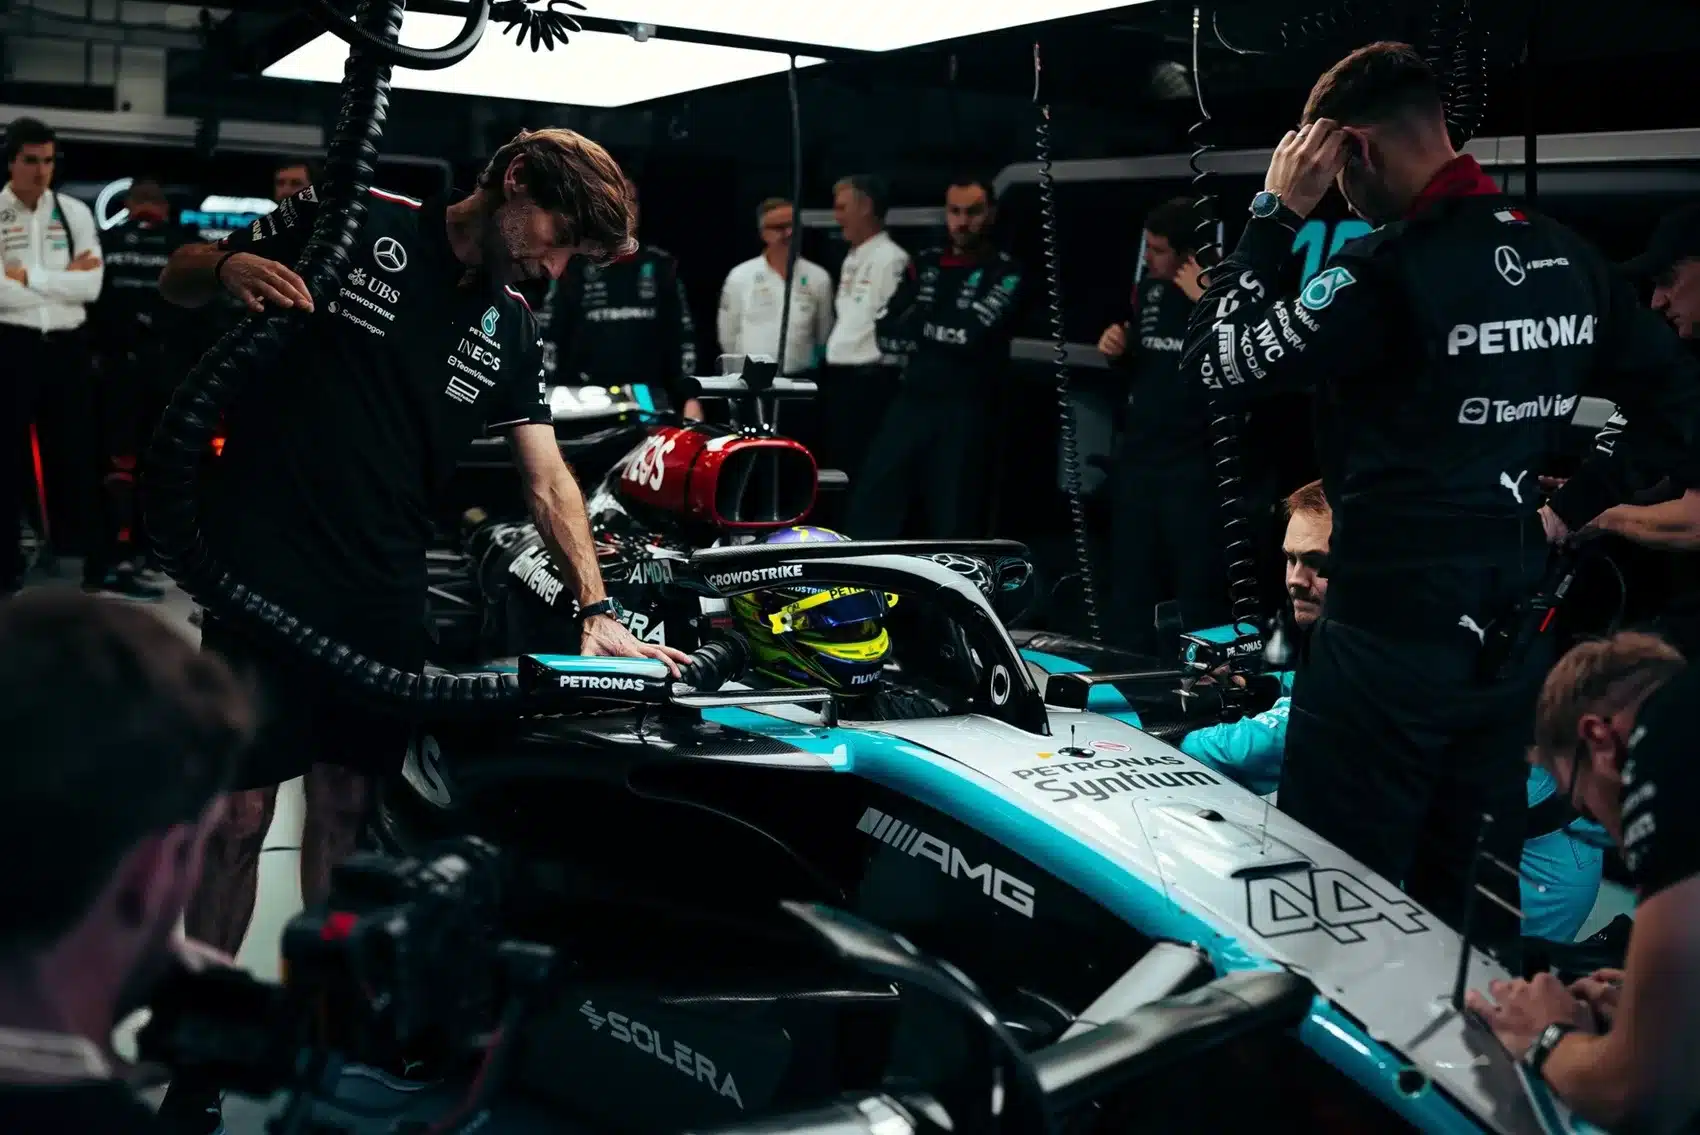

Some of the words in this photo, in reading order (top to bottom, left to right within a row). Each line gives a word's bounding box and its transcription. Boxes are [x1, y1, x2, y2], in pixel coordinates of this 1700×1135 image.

[340, 287, 396, 321] CROWDSTRIKE
[367, 276, 401, 304] UBS
[341, 308, 385, 337] Snapdragon
[1447, 314, 1599, 356] PETRONA
[469, 326, 501, 350] PETRONAS
[1252, 318, 1285, 363] IWC
[457, 338, 501, 371] INEOS
[456, 360, 496, 388] TeamViewer
[1492, 394, 1580, 424] TeamVie
[709, 564, 804, 587] CROWDSTRIKE
[559, 675, 645, 692] PETRONAS
[850, 670, 881, 685] nuve
[1011, 756, 1185, 780] PETRONAS
[1033, 769, 1221, 802] Syntium
[907, 831, 1036, 919] AMG
[1245, 868, 1430, 944] 44
[606, 1010, 745, 1111] SOLERA
